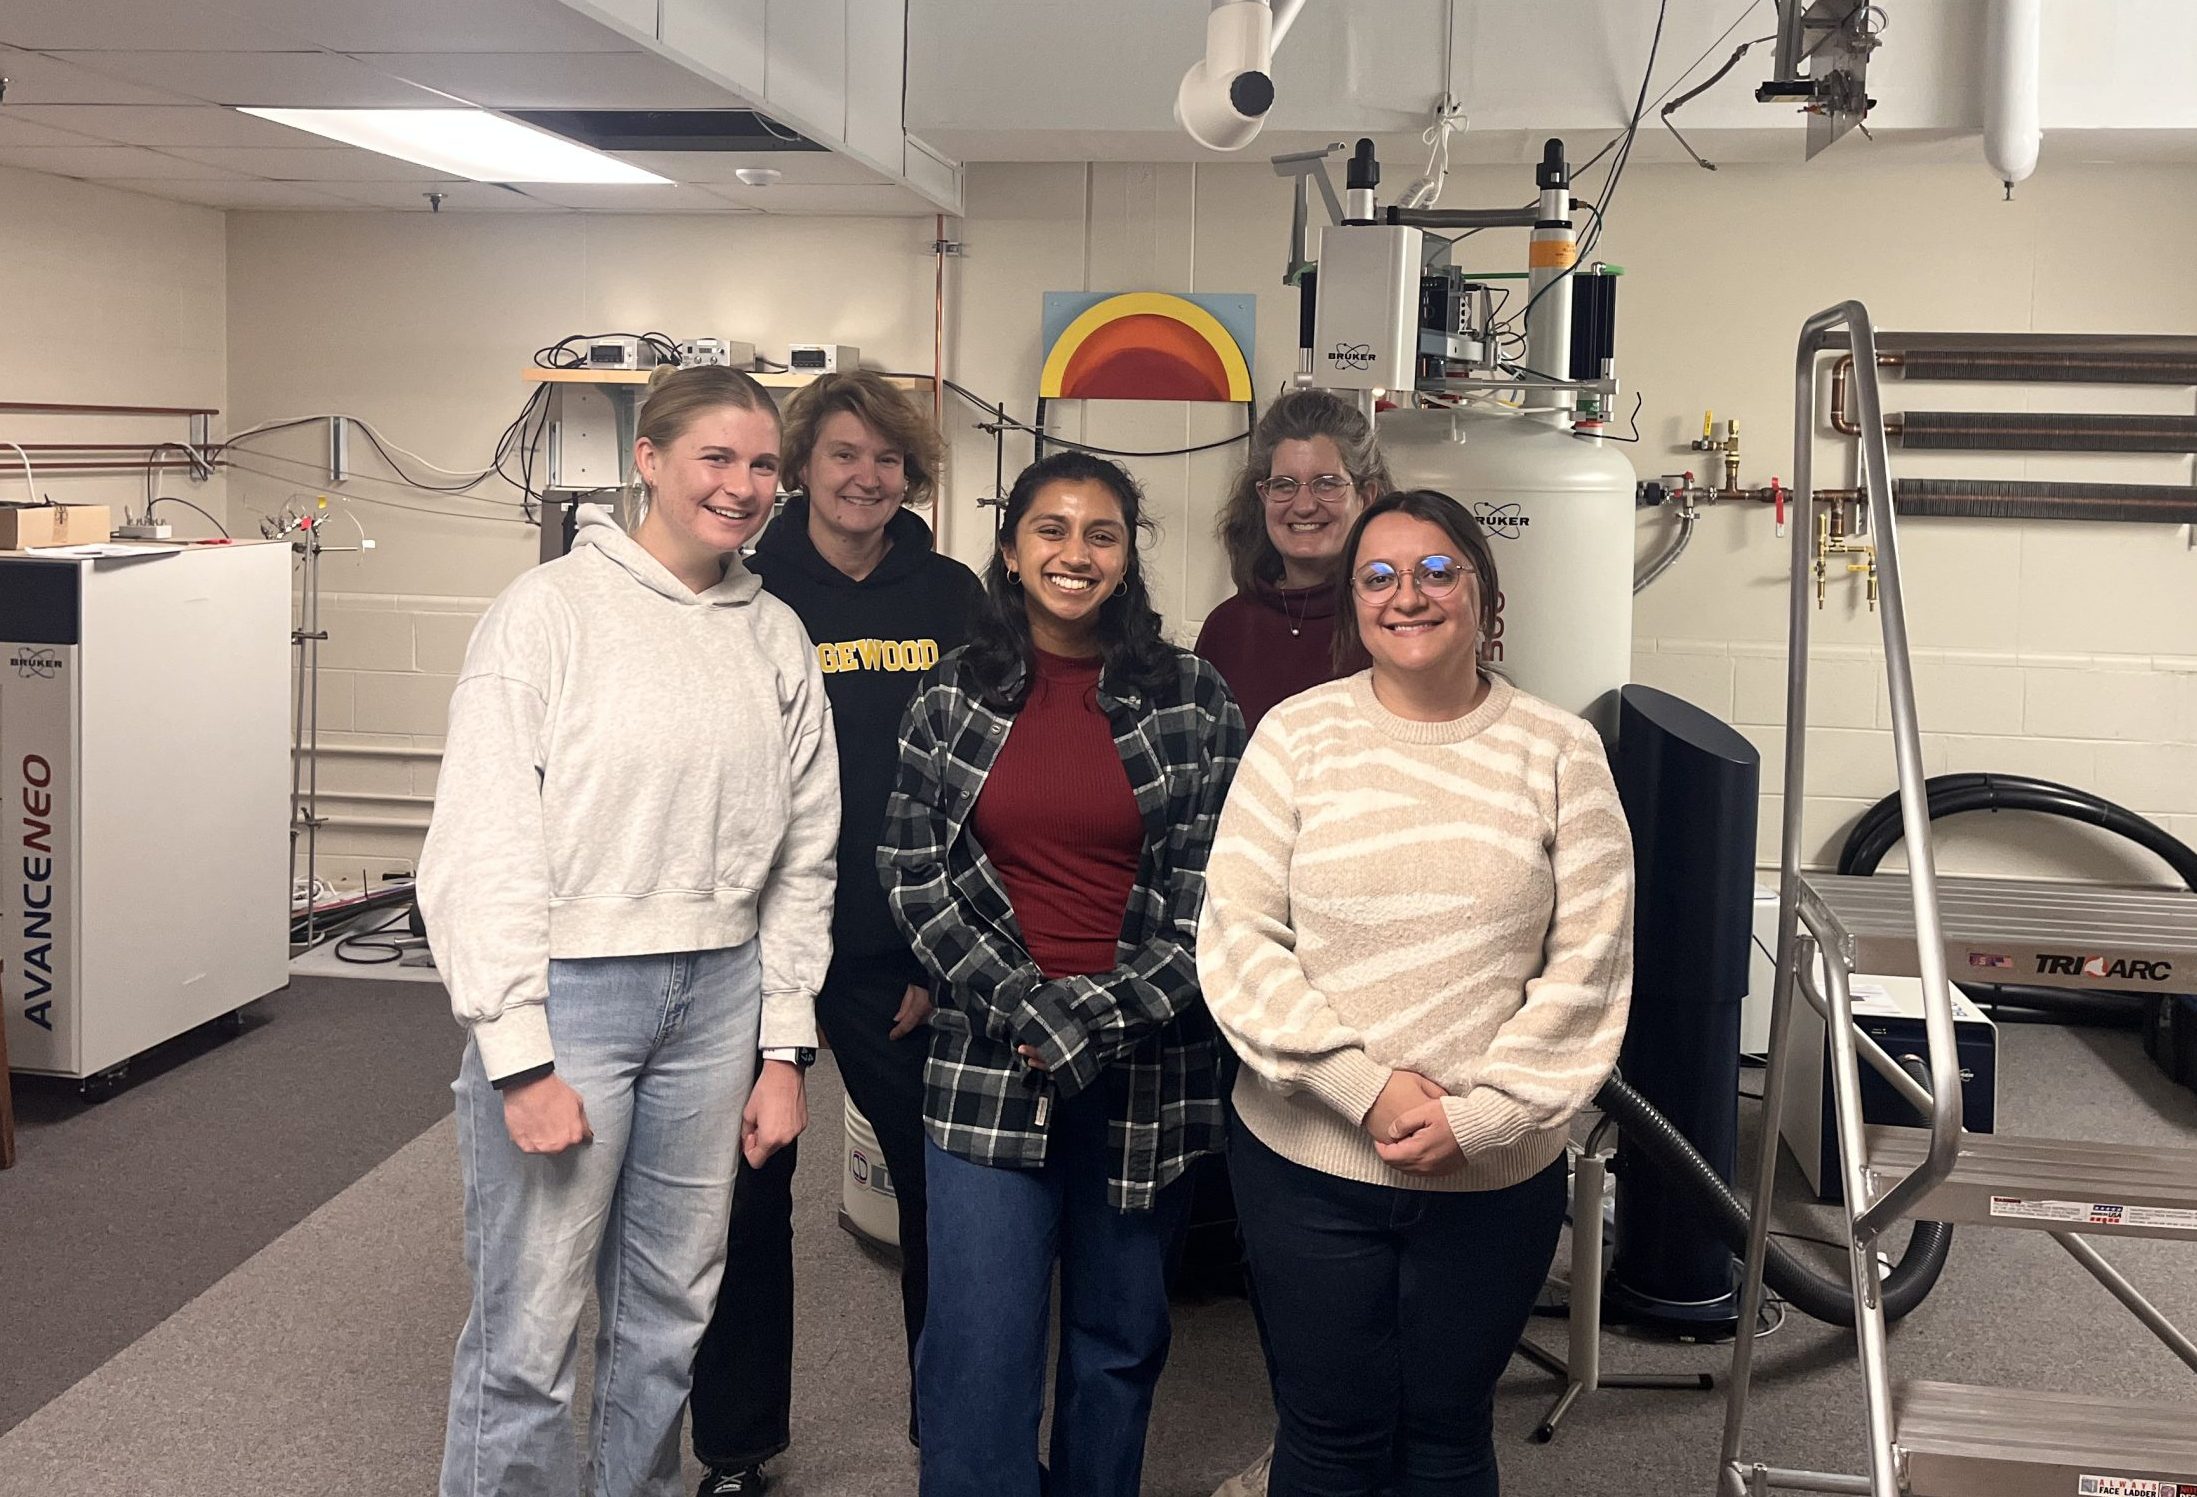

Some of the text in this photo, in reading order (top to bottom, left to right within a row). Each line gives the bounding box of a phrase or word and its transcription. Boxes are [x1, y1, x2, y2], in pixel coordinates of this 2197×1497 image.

[1328, 352, 1376, 361] BRUKER
[1475, 516, 1530, 526] RUKER
[817, 638, 939, 674] GEWOOD
[10, 658, 62, 668] BRUKER
[2099, 1479, 2157, 1490] ALWAYS
[2099, 1487, 2157, 1497] FACE LADDER
